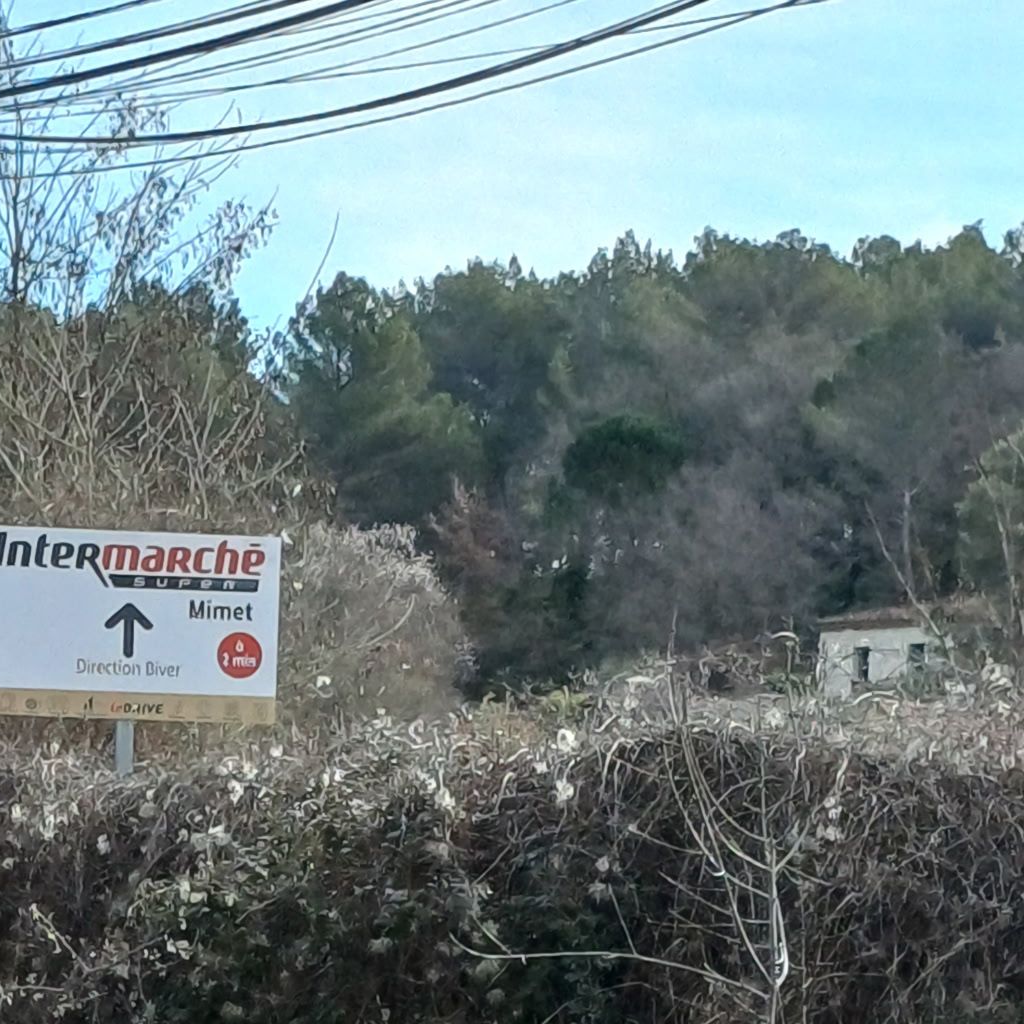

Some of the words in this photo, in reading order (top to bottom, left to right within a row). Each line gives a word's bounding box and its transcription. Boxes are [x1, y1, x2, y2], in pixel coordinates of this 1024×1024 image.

[188, 600, 253, 621] Mimet
[76, 658, 141, 676] Direction
[145, 661, 181, 677] Biver
